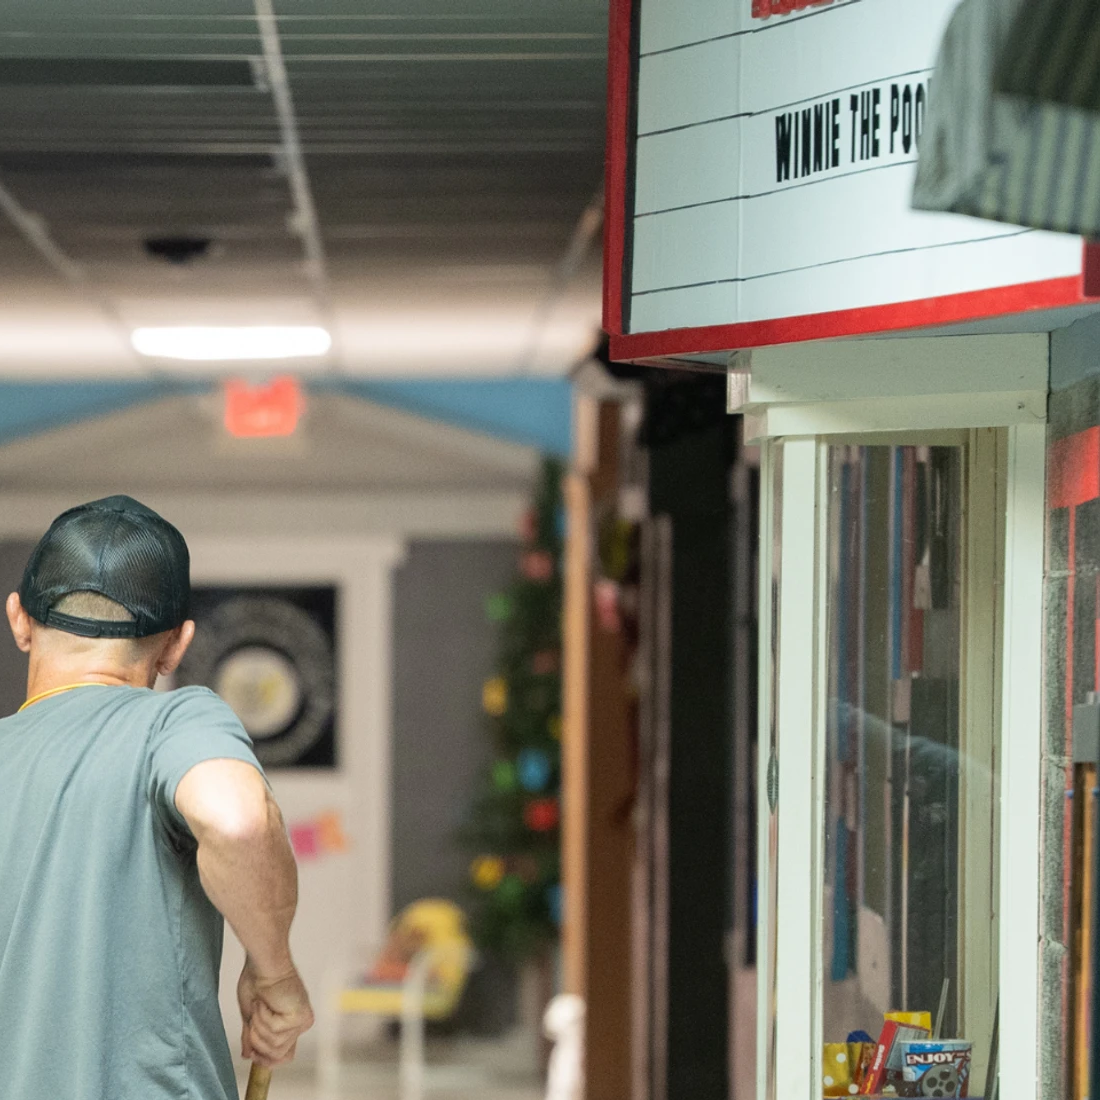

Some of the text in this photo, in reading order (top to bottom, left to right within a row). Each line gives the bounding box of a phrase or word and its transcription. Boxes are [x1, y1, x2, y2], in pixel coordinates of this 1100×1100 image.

[775, 77, 932, 183] WINNIE THE POO
[906, 1052, 955, 1064] ENJOY
